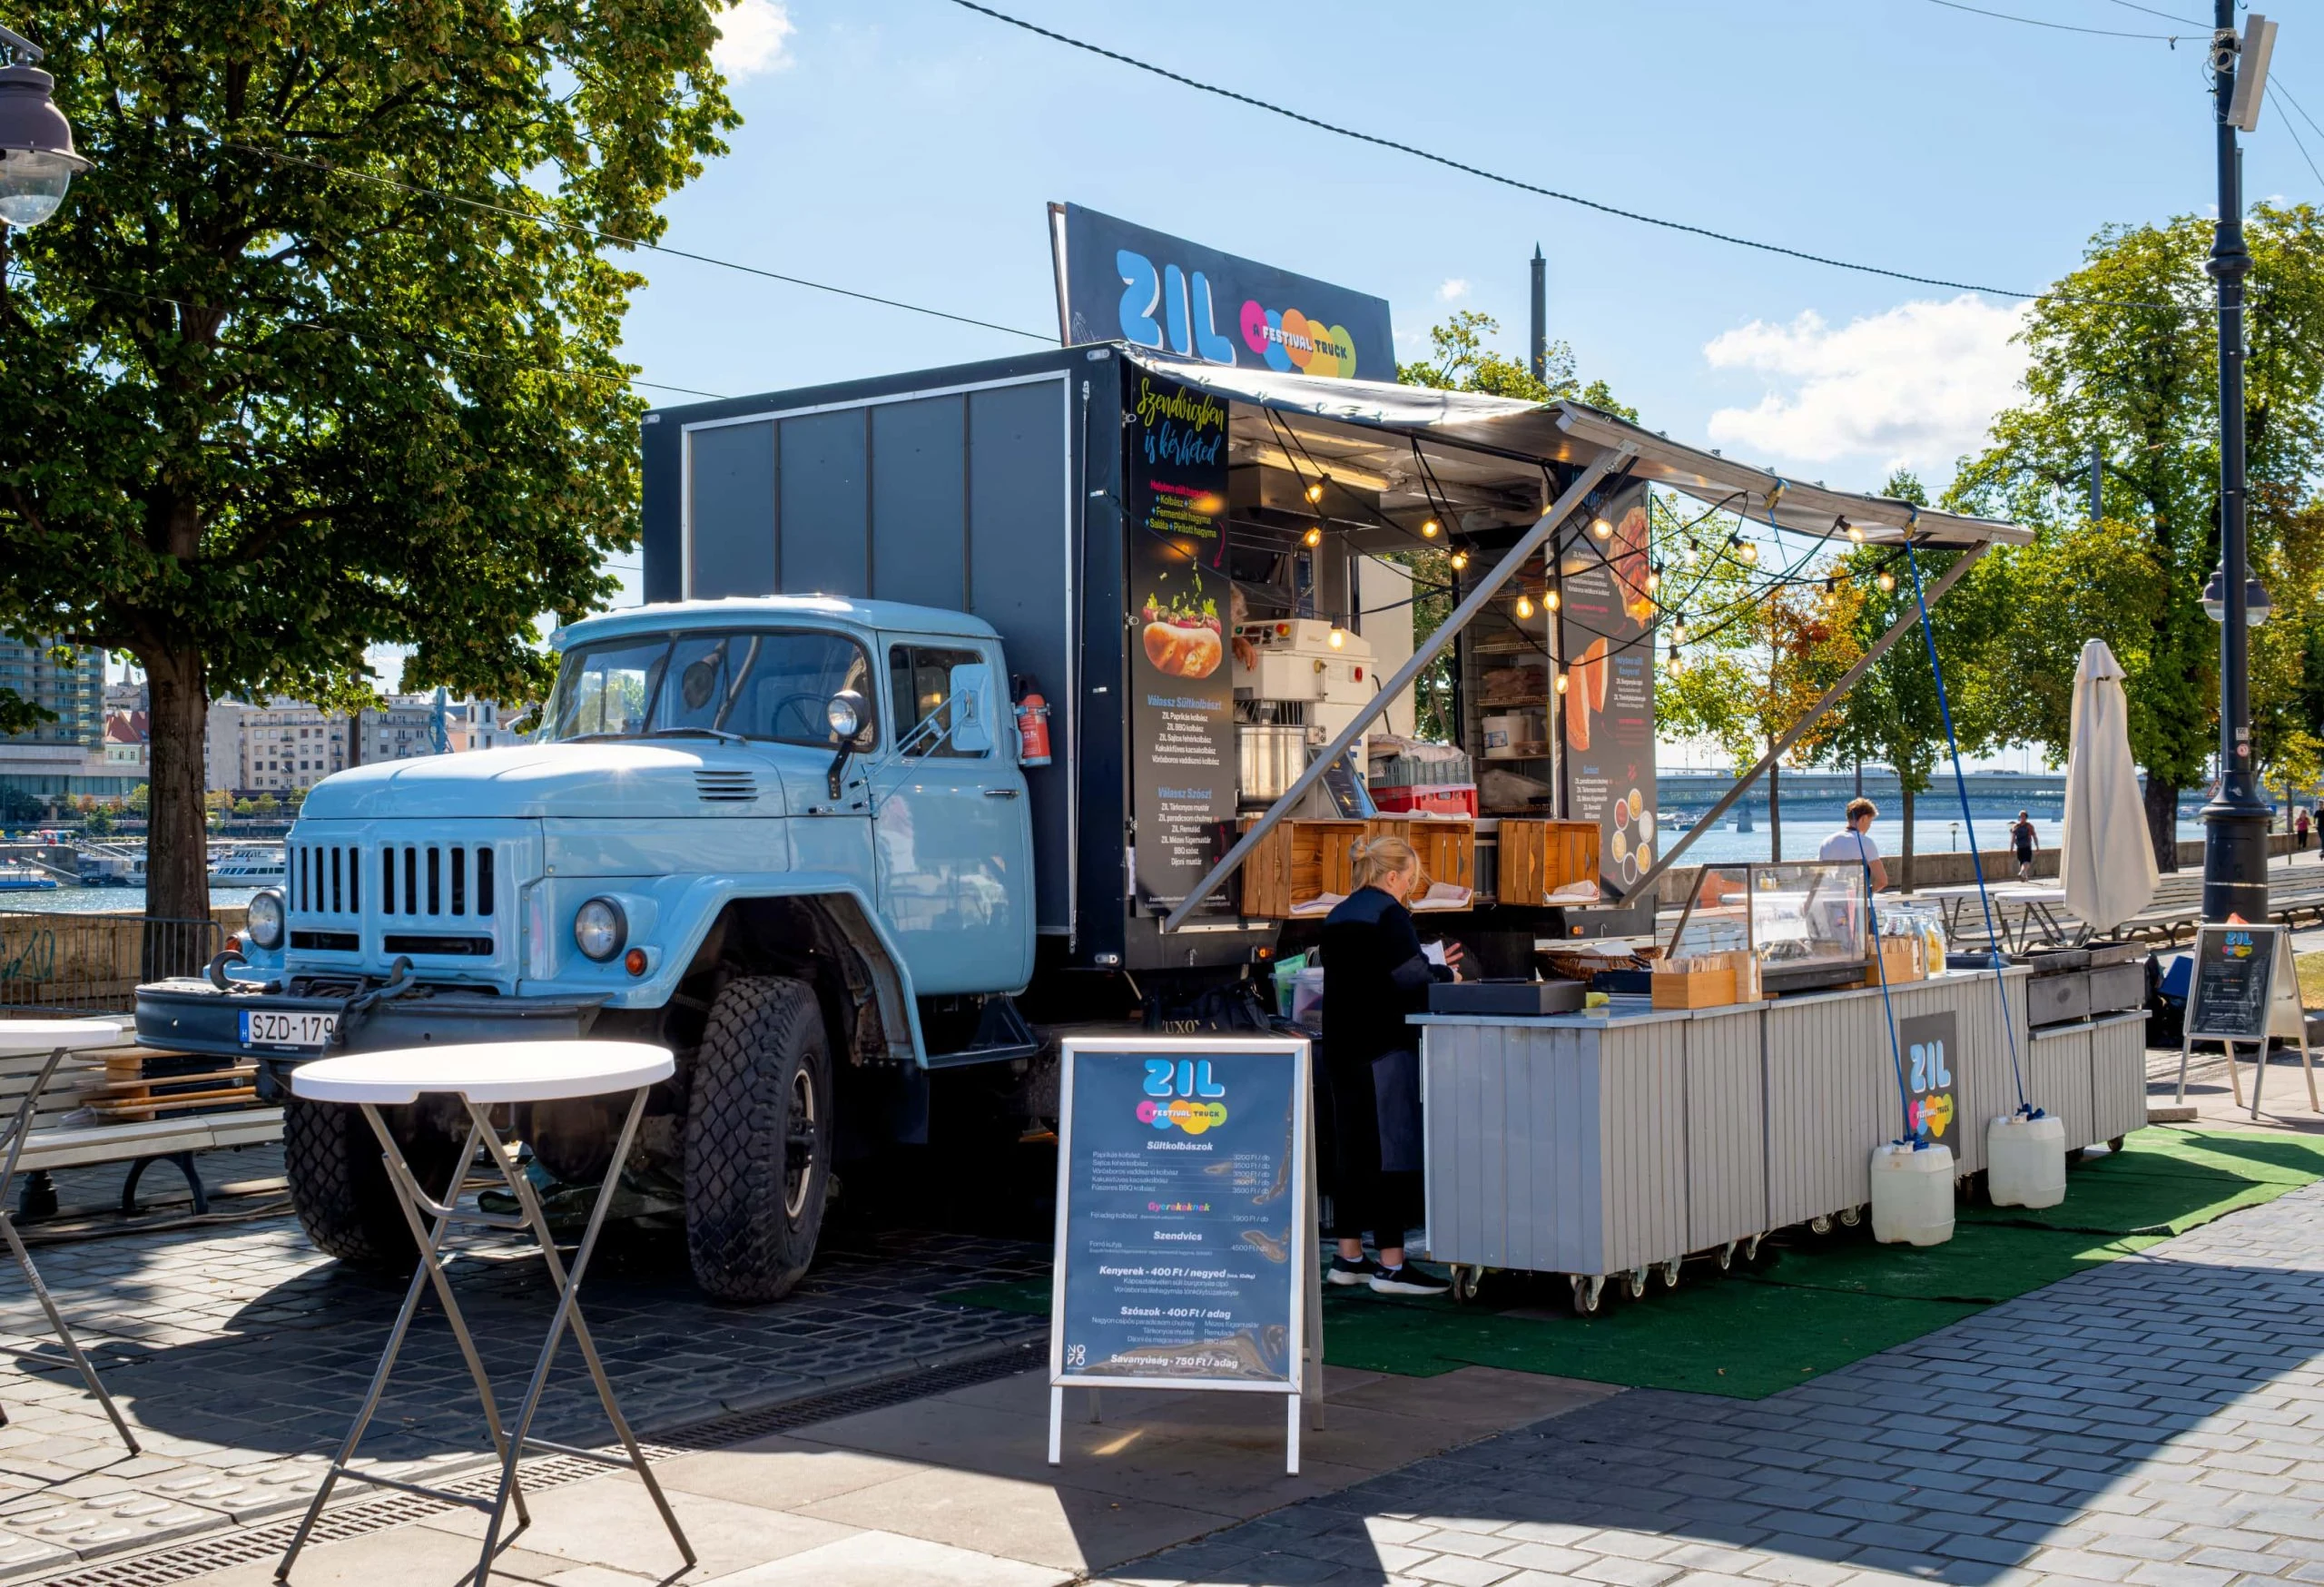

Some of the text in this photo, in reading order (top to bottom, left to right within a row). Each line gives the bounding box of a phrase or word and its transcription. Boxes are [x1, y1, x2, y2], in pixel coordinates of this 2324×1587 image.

[1117, 250, 1236, 368] ZIL
[1253, 323, 1347, 360] A FESTIVAL TRUCK
[1137, 377, 1224, 432] Szendvicsben
[1145, 420, 1221, 466] is kérheted
[1160, 494, 1184, 507] Kolbász
[1156, 506, 1212, 525] Fermentált hagyma
[1149, 518, 1168, 529] Saláta
[1194, 527, 1216, 537] hagyma
[1190, 713, 1208, 723] kolbász
[1186, 724, 1204, 733] kolbász
[2225, 932, 2253, 944] ZIL
[252, 1014, 334, 1041] SZD-179
[1909, 1040, 1951, 1094] ZIL
[1143, 1059, 1226, 1098] ZIL
[1147, 1140, 1213, 1151] Sültkolbászok
[1147, 1201, 1211, 1212] Gyerekeknek
[1153, 1231, 1203, 1241] Szendvics
[1099, 1266, 1144, 1276] Kenyerek
[1151, 1267, 1171, 1276] 400
[1172, 1267, 1182, 1276] Ft
[1184, 1267, 1189, 1276] /
[1190, 1269, 1226, 1279] negyed
[1120, 1306, 1160, 1316] Szószok
[1167, 1307, 1187, 1316] 400
[1189, 1308, 1199, 1317] Ft
[1200, 1308, 1206, 1317] /
[1206, 1309, 1231, 1320] adag
[1110, 1354, 1168, 1366] Savanyúság
[1175, 1356, 1195, 1365] 750
[1195, 1357, 1206, 1365] Ft
[1207, 1357, 1213, 1366] /
[1214, 1358, 1238, 1369] adag
